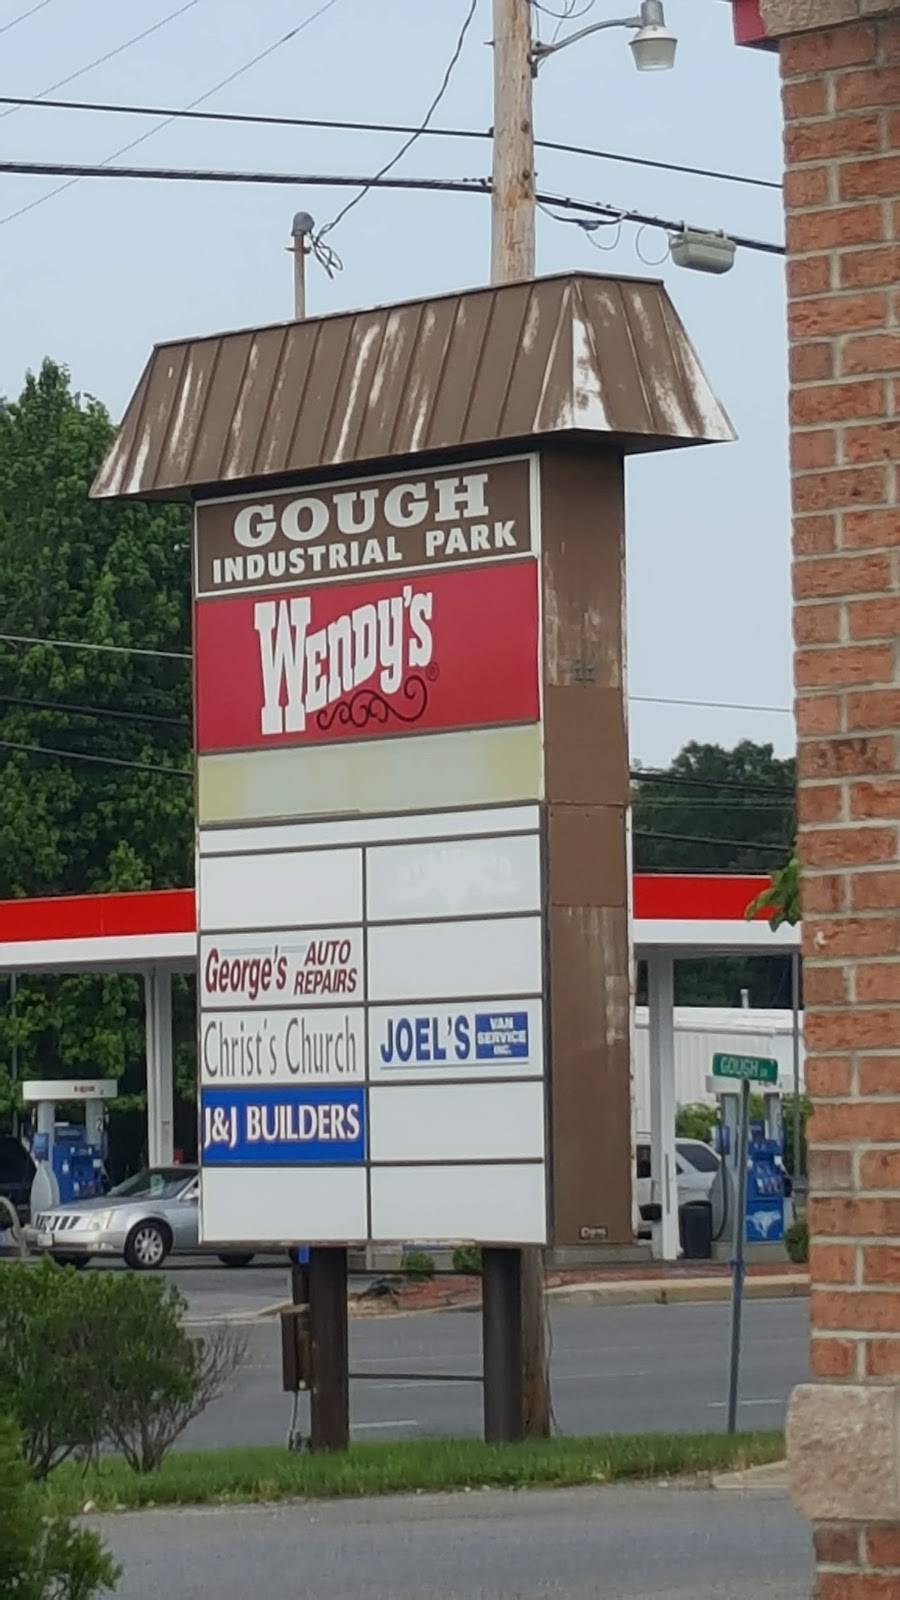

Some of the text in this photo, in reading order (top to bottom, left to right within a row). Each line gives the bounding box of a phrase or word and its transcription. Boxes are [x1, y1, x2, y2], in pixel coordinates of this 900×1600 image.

[233, 473, 489, 548] GOUGH
[212, 520, 517, 584] INDUSTRIAL PARK
[205, 945, 288, 1001] George's
[304, 940, 351, 966] AUTO
[293, 968, 357, 995] REPAIRS
[203, 1015, 356, 1077] Christ's Church
[380, 1014, 470, 1063] JOEL'S
[477, 1030, 527, 1045] SERVICE
[490, 1016, 514, 1030] VAN
[204, 1104, 360, 1149] J&J BUILDERS
